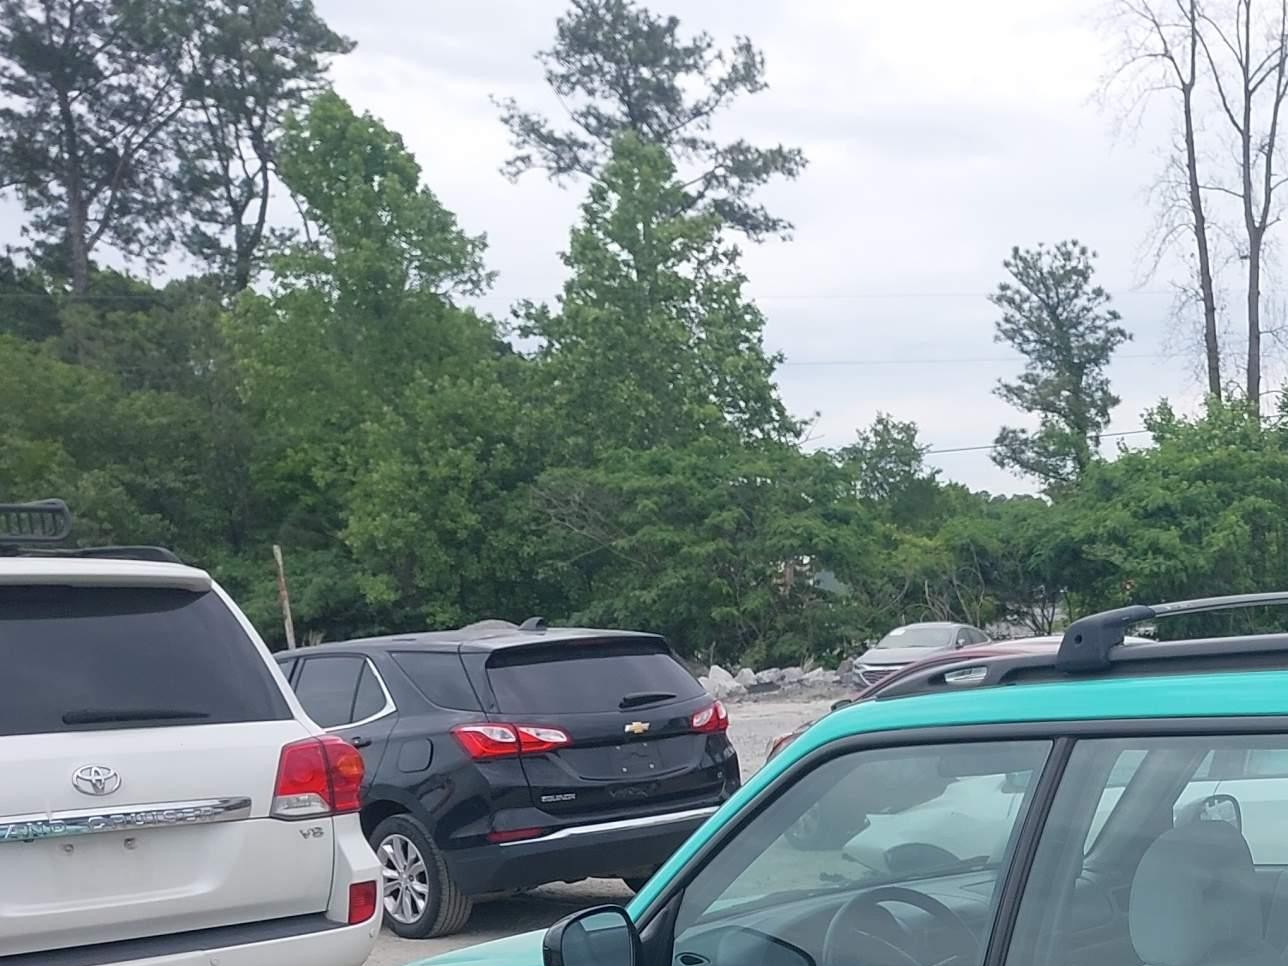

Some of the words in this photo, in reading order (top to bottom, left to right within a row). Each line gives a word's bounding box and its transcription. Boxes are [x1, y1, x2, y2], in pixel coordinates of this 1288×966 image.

[3, 818, 66, 841] AND
[88, 806, 219, 834] CRUISER
[299, 826, 325, 840] V8
